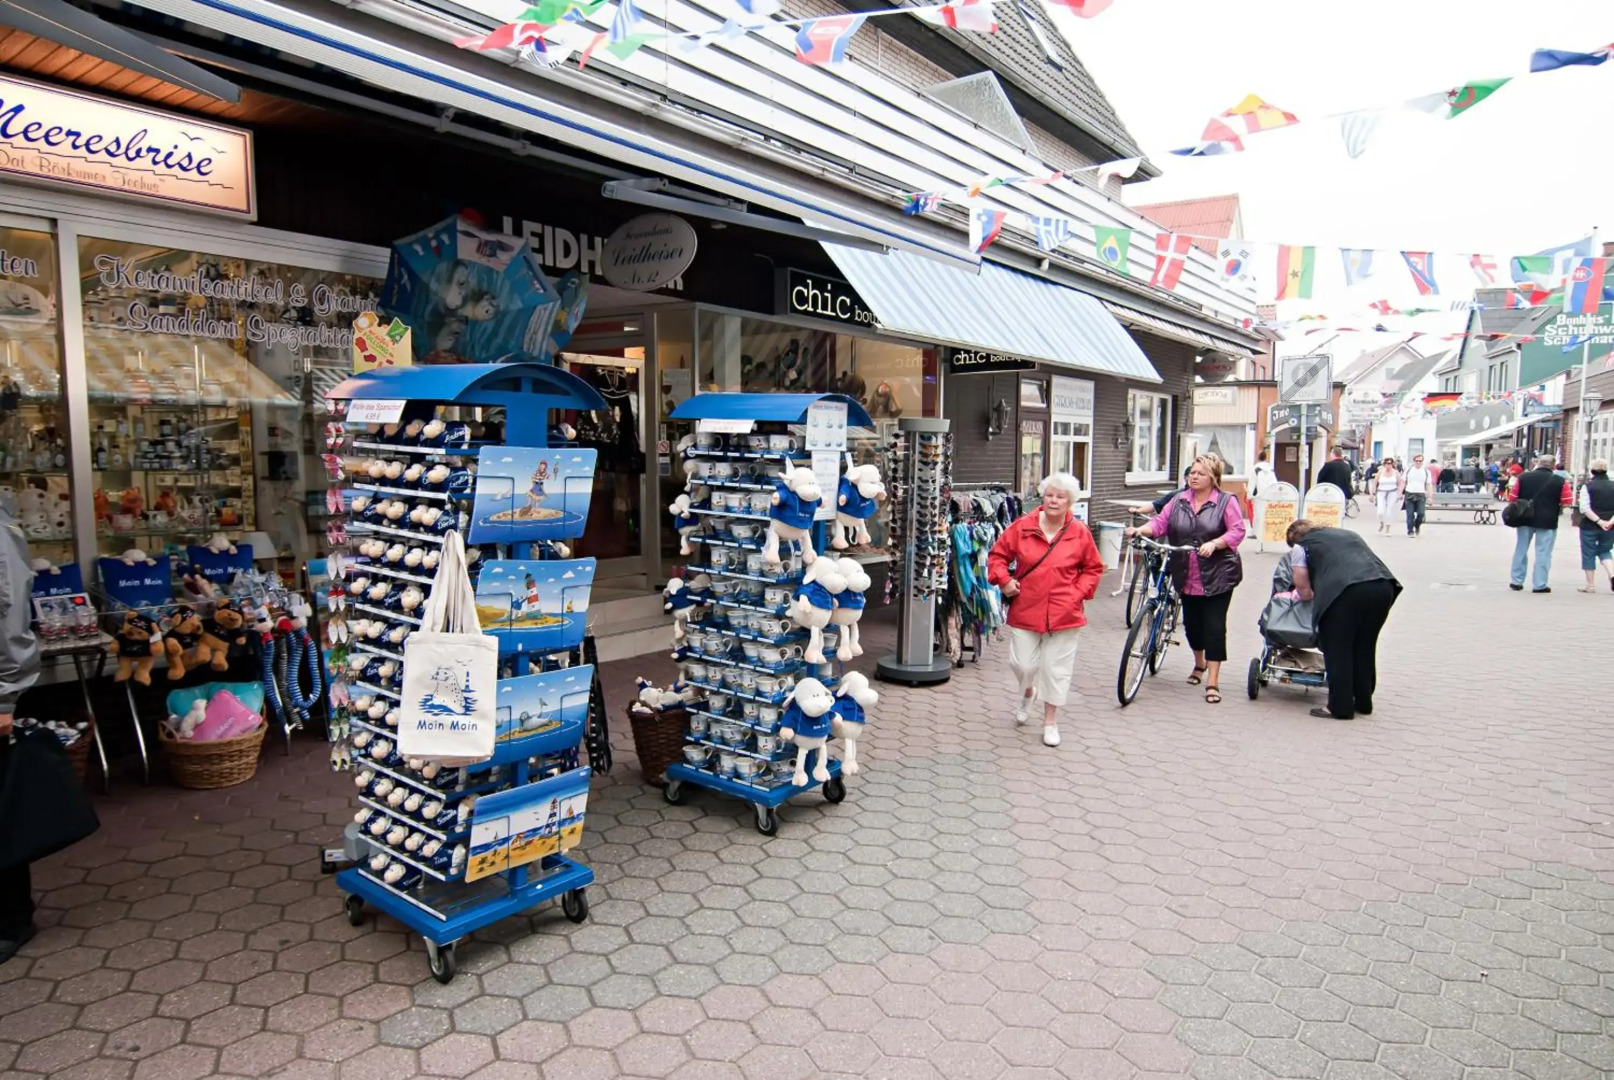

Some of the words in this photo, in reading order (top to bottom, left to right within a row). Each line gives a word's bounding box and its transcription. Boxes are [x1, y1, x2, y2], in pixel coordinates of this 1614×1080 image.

[290, 284, 308, 307] &
[792, 280, 851, 319] chic
[127, 299, 240, 339] Sanddorn
[953, 350, 987, 366] chic
[119, 579, 140, 587] Moin
[417, 720, 445, 731] Moin
[450, 720, 478, 731] Moin
